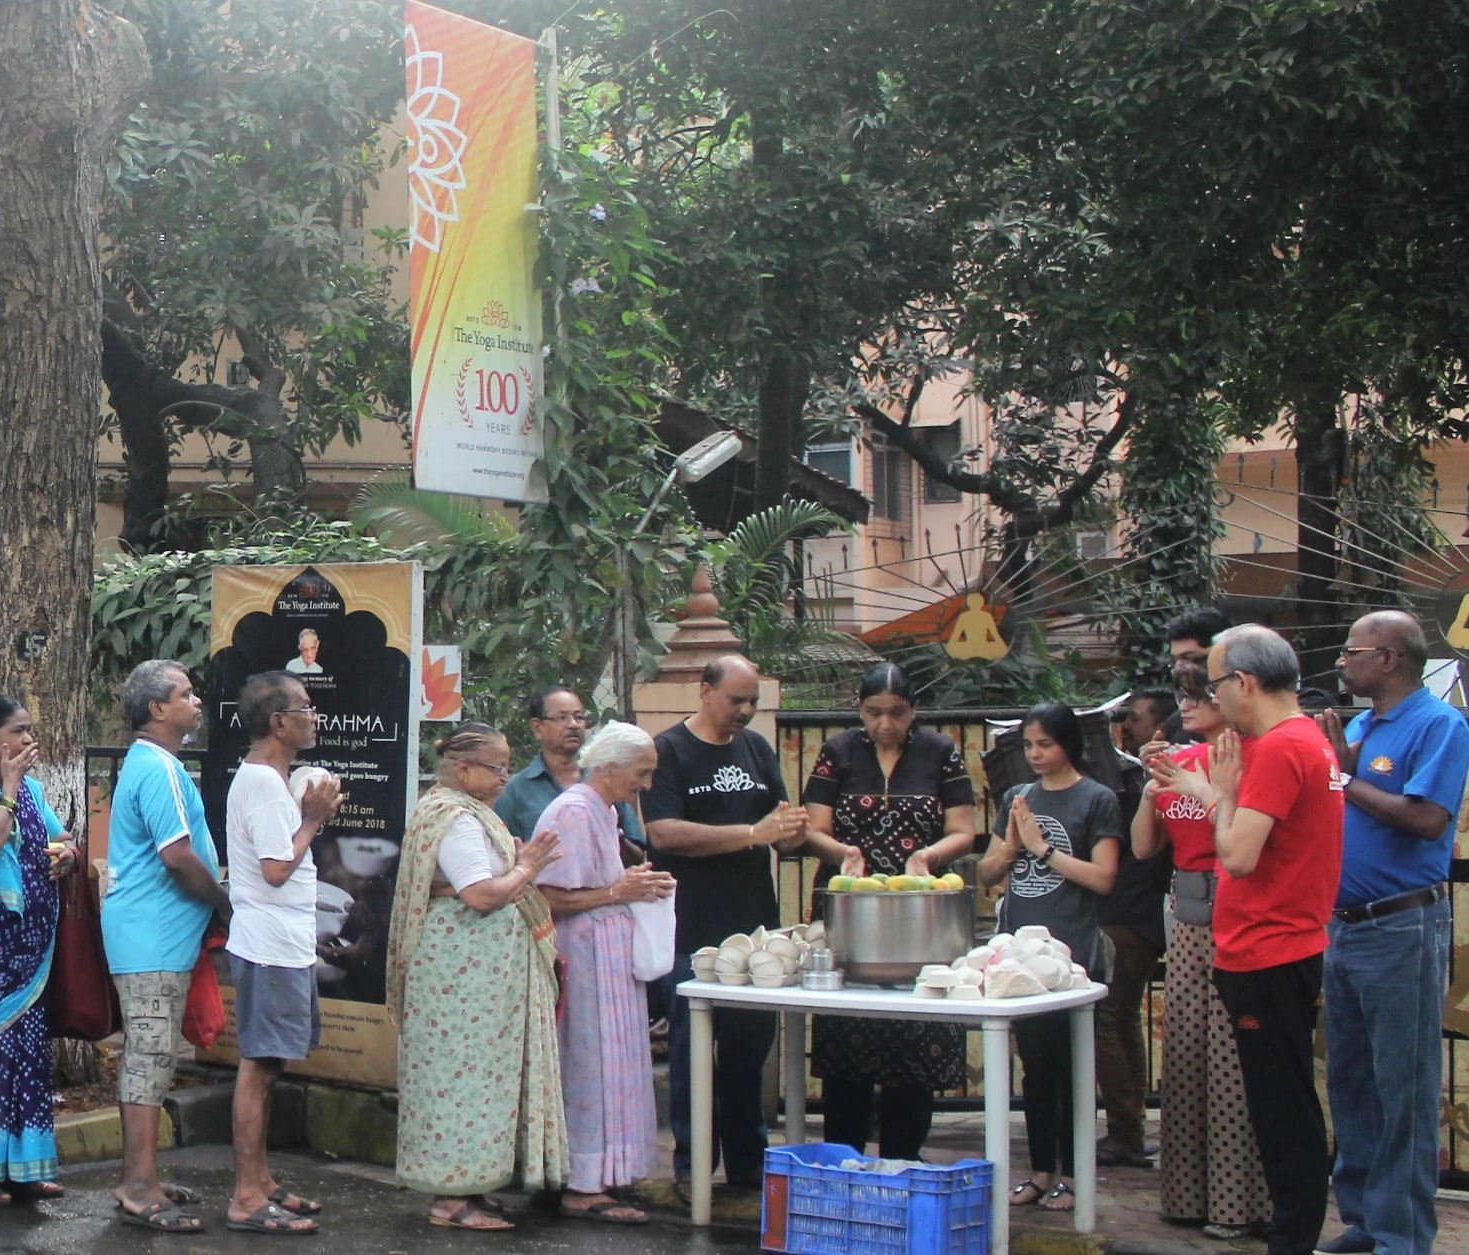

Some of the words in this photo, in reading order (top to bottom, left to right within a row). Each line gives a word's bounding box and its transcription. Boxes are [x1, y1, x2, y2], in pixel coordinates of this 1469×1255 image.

[455, 327, 473, 344] The
[473, 330, 496, 351] Yoga
[475, 368, 518, 416] 100
[485, 421, 511, 436] YEARS
[278, 601, 291, 609] The
[292, 601, 308, 612] Yoga
[309, 600, 340, 609] Institute
[317, 713, 384, 732] RAHMA
[319, 736, 340, 746] Food
[342, 736, 350, 746] is
[351, 737, 367, 750] god
[333, 760, 348, 769] Yoga
[349, 761, 378, 769] Institute
[364, 772, 389, 782] hungry
[689, 785, 712, 795] ESTD
[339, 804, 358, 814] 8:15
[360, 807, 374, 815] am
[342, 818, 363, 828] June
[365, 819, 385, 829] 2018
